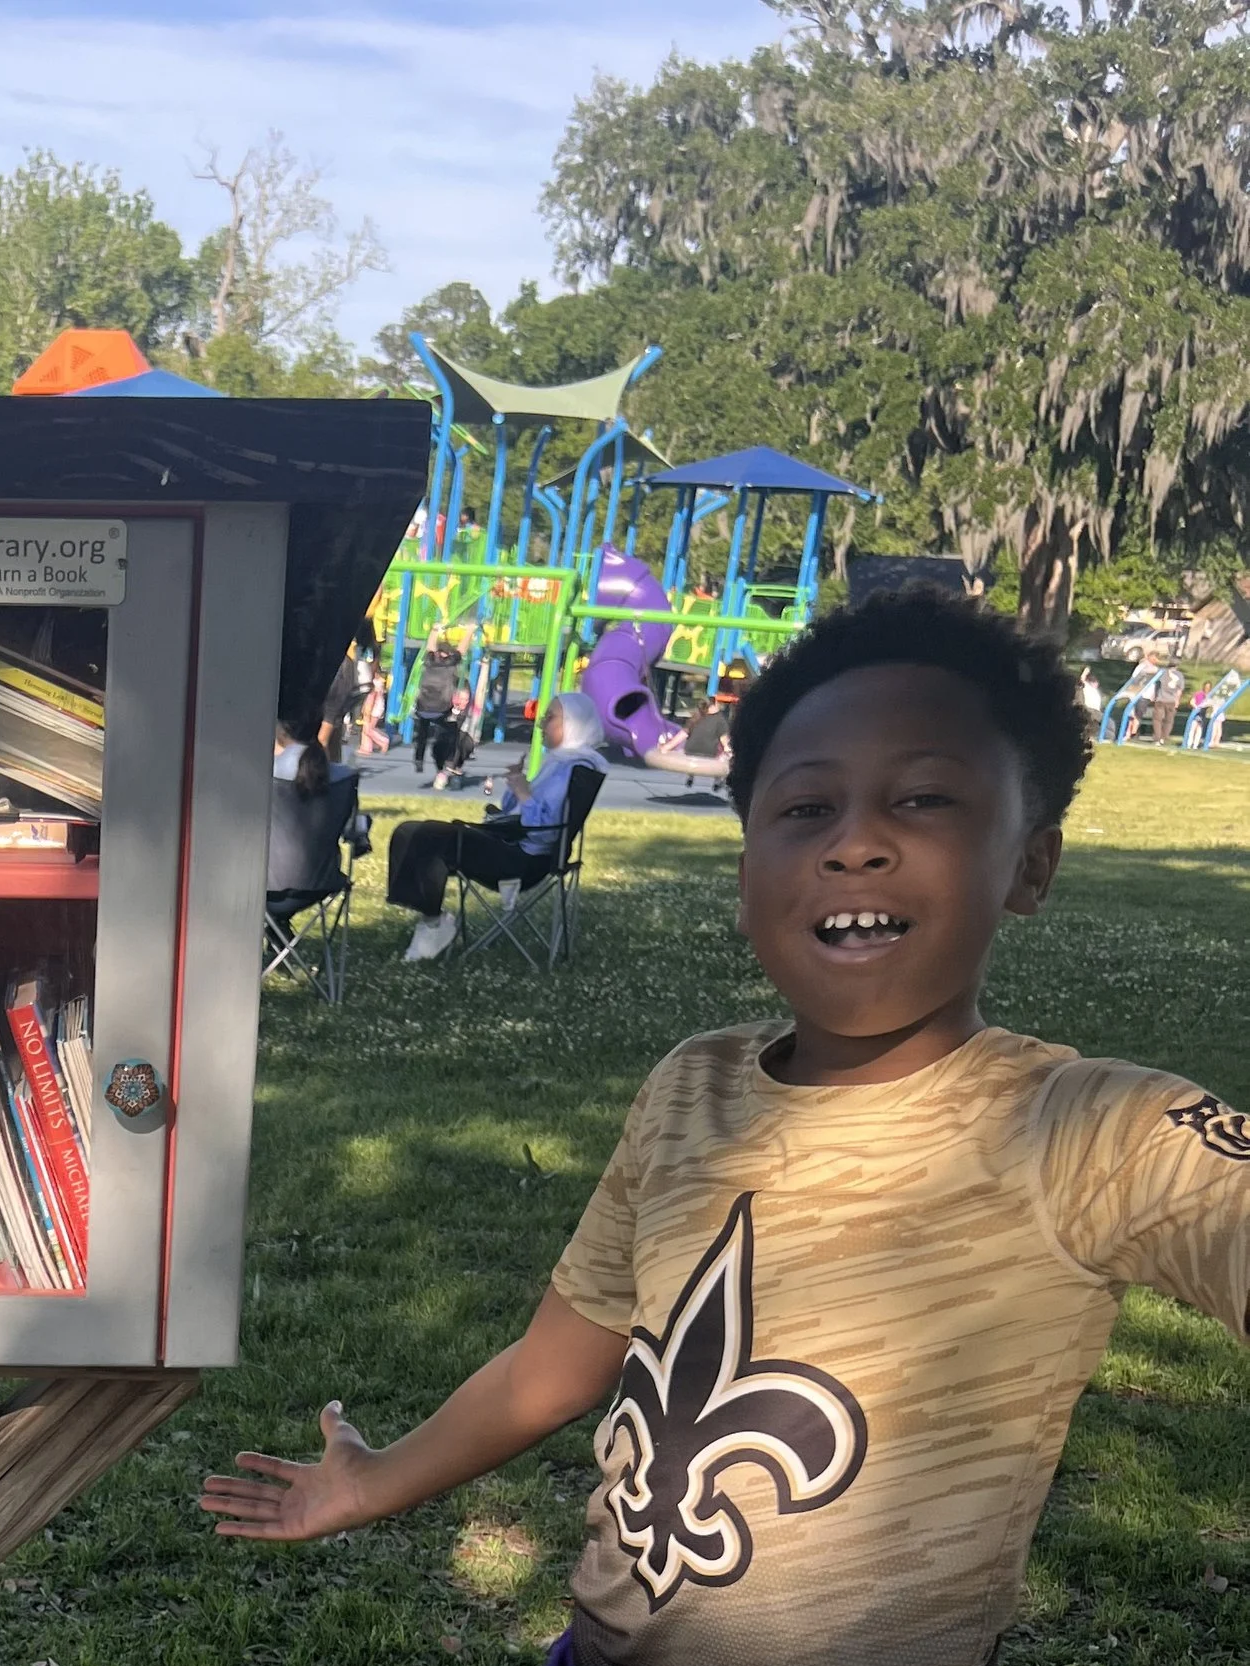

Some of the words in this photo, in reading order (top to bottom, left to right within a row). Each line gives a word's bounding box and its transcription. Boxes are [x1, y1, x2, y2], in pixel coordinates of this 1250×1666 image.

[5, 587, 47, 597] Nonprofit
[48, 587, 106, 599] Organization
[27, 568, 37, 583] a
[43, 565, 88, 583] Book
[19, 1020, 43, 1056] NO
[31, 1060, 68, 1131] LIMITS
[61, 1148, 91, 1219] MICHAEL
